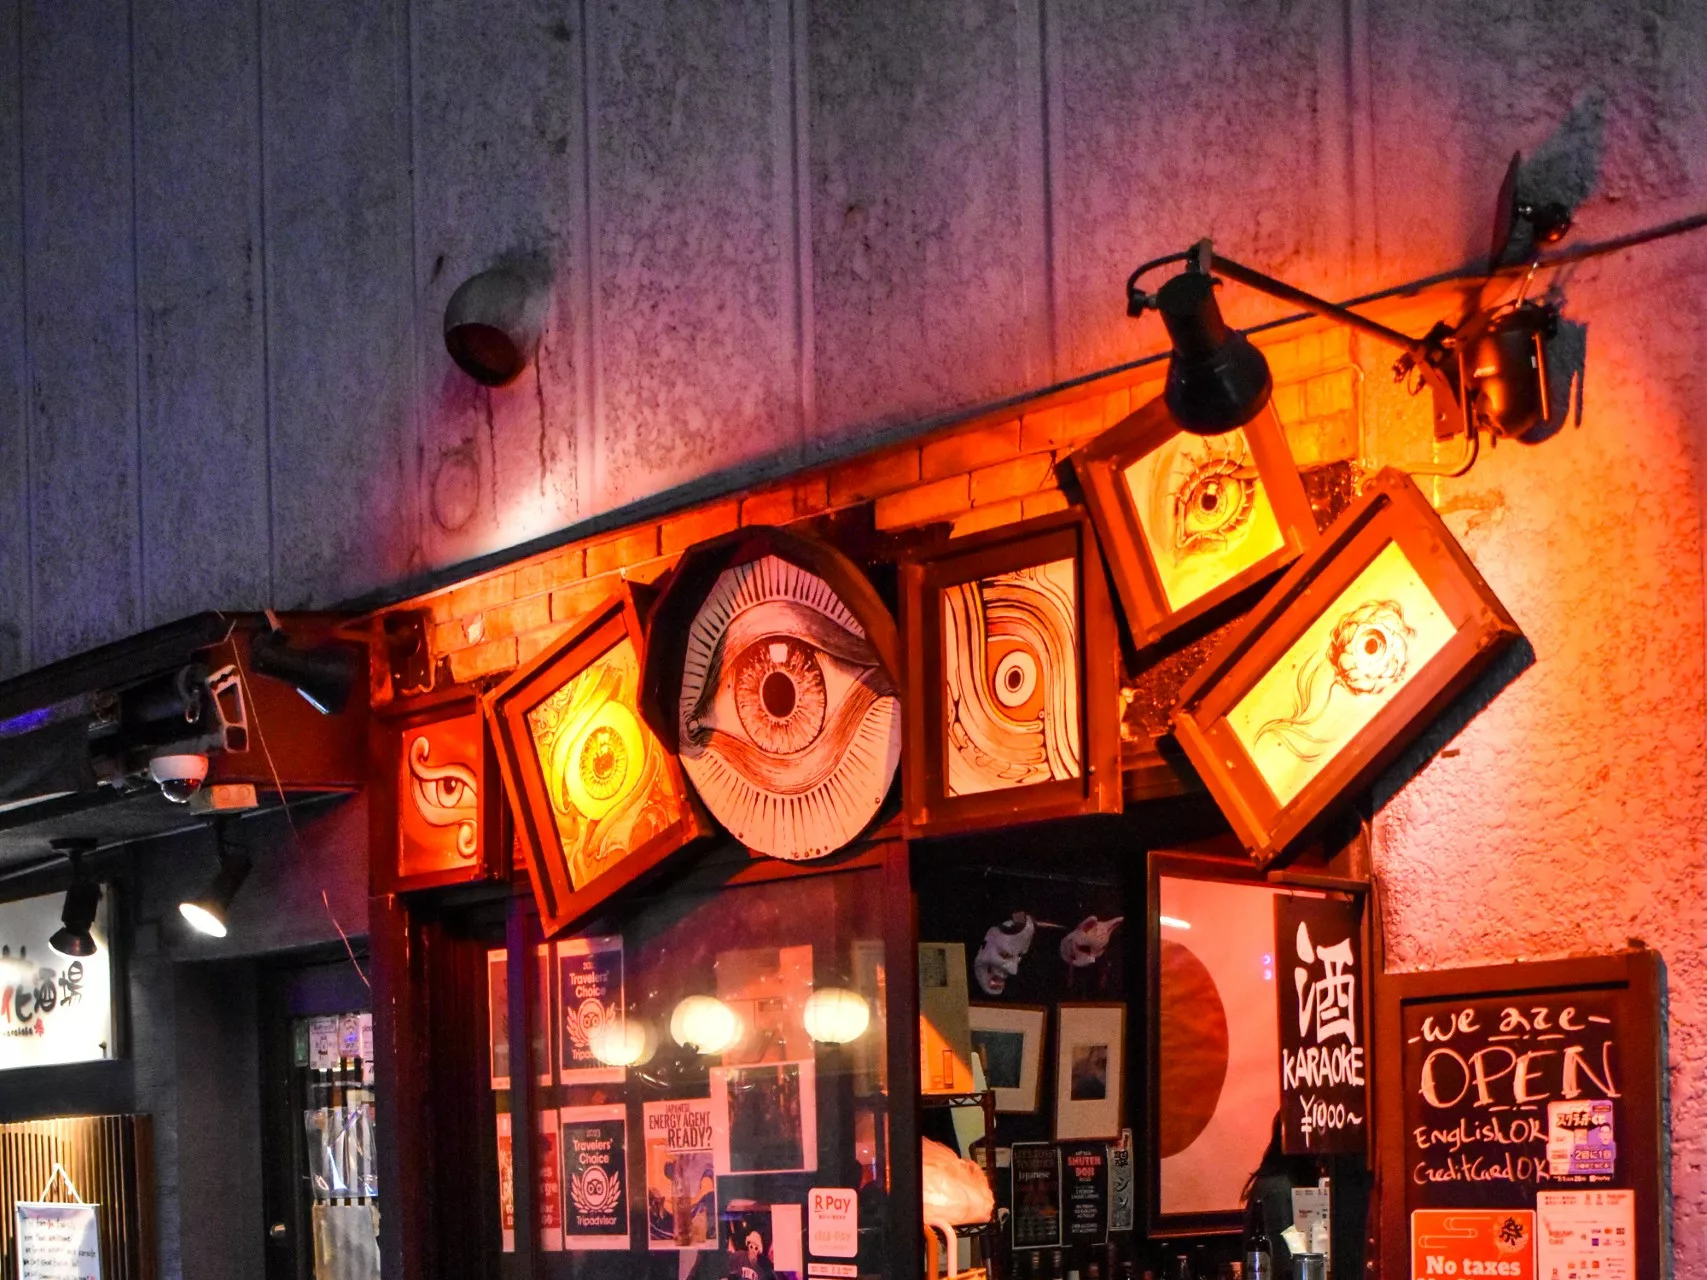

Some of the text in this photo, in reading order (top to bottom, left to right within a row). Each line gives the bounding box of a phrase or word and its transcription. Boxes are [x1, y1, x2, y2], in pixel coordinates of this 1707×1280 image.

[575, 985, 606, 998] Choice
[1294, 921, 1354, 1045] 酒
[1283, 1047, 1364, 1090] KARAOKE
[1419, 1041, 1622, 1109] OPEN
[649, 1111, 710, 1130] ENERGY AGENT
[1510, 1119, 1549, 1143] OK
[573, 1138, 613, 1152] Travelers'
[668, 1126, 713, 1149] READY?
[579, 1152, 609, 1164] Choice
[1517, 1156, 1550, 1183] OK
[826, 1195, 851, 1214] Pay
[576, 1216, 618, 1226] Tripadvisor
[1426, 1255, 1521, 1276] No taxes
